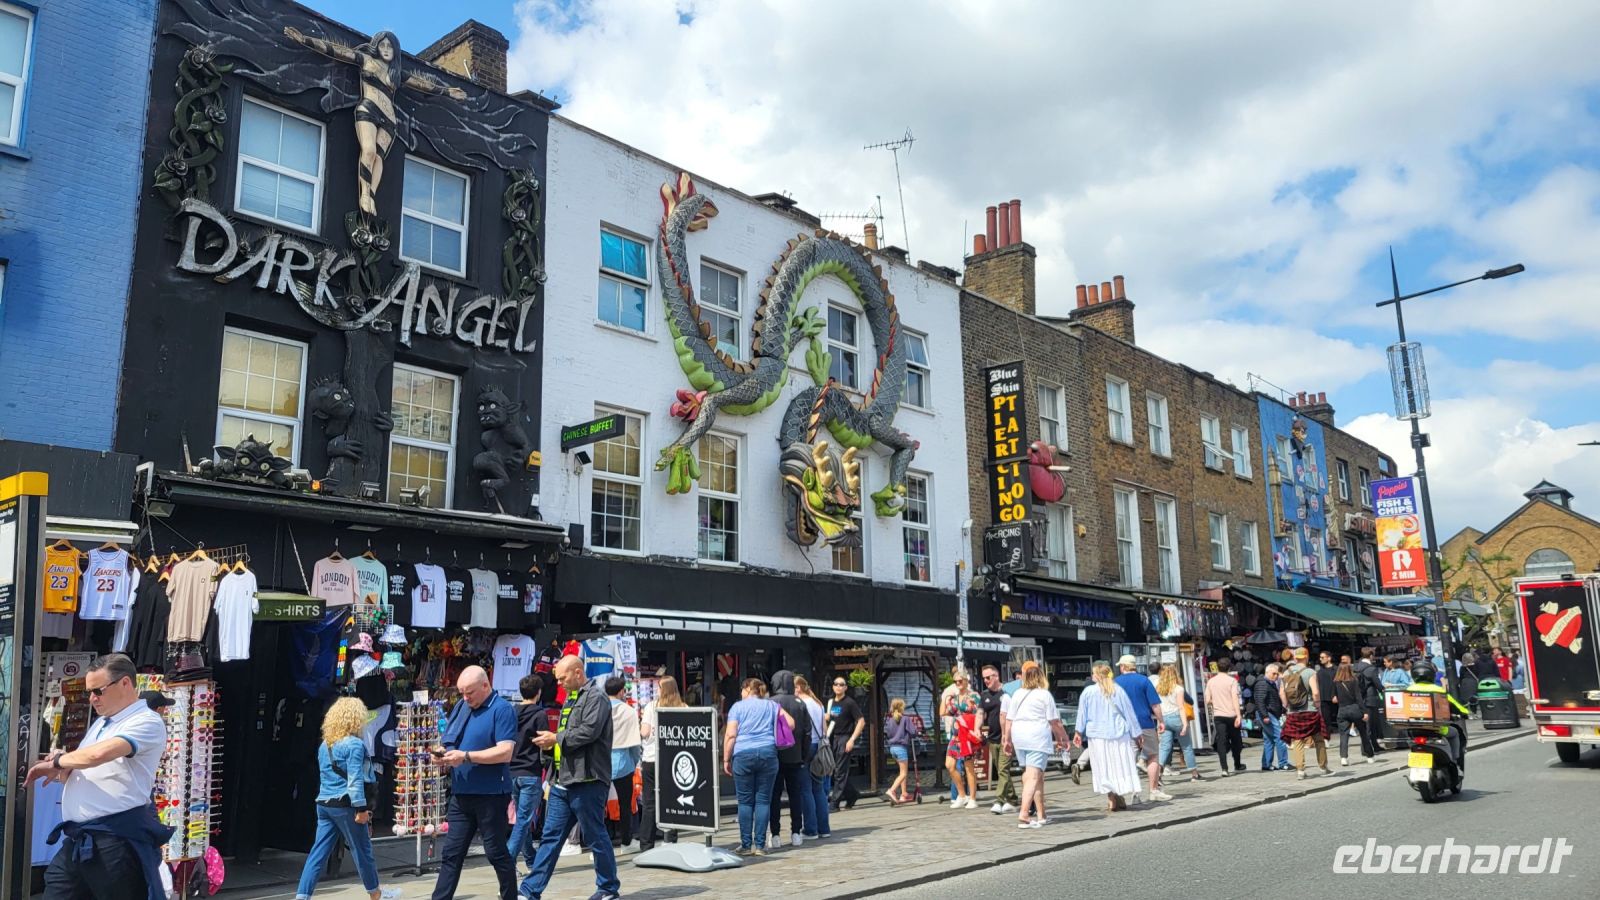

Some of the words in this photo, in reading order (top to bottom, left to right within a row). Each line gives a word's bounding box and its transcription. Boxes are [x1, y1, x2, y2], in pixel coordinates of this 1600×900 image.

[176, 198, 356, 316] DARK
[361, 262, 536, 353] ANGEL
[989, 368, 1017, 383] Blue
[990, 382, 1020, 398] Skin
[563, 426, 588, 442] CHINESE
[589, 418, 614, 435] BUFFET
[993, 395, 1013, 522] PIERCING
[1005, 394, 1025, 521] TATTOO
[1378, 481, 1408, 500] Poppies
[1376, 498, 1401, 509] FISH
[1403, 497, 1412, 506] &
[1377, 505, 1414, 516] CHIPS
[1001, 538, 1008, 549] &
[48, 564, 75, 573] LAKERS
[93, 567, 122, 577] LAKERS
[1392, 571, 1397, 580] 2
[1399, 570, 1417, 580] MIN
[51, 576, 69, 589] 23
[320, 572, 350, 587] LONDON
[356, 570, 381, 586] ONDON
[97, 579, 115, 592] 23
[1024, 594, 1071, 616] BLUE
[635, 630, 648, 640] You
[649, 631, 663, 640] Can
[664, 632, 676, 641] Eat
[505, 646, 509, 656] I
[502, 656, 522, 667] LONDON
[1390, 695, 1399, 705] L
[659, 725, 685, 740] BLACK
[687, 725, 712, 741] ROSE
[665, 739, 679, 747] tattoo
[685, 740, 706, 749] piercing
